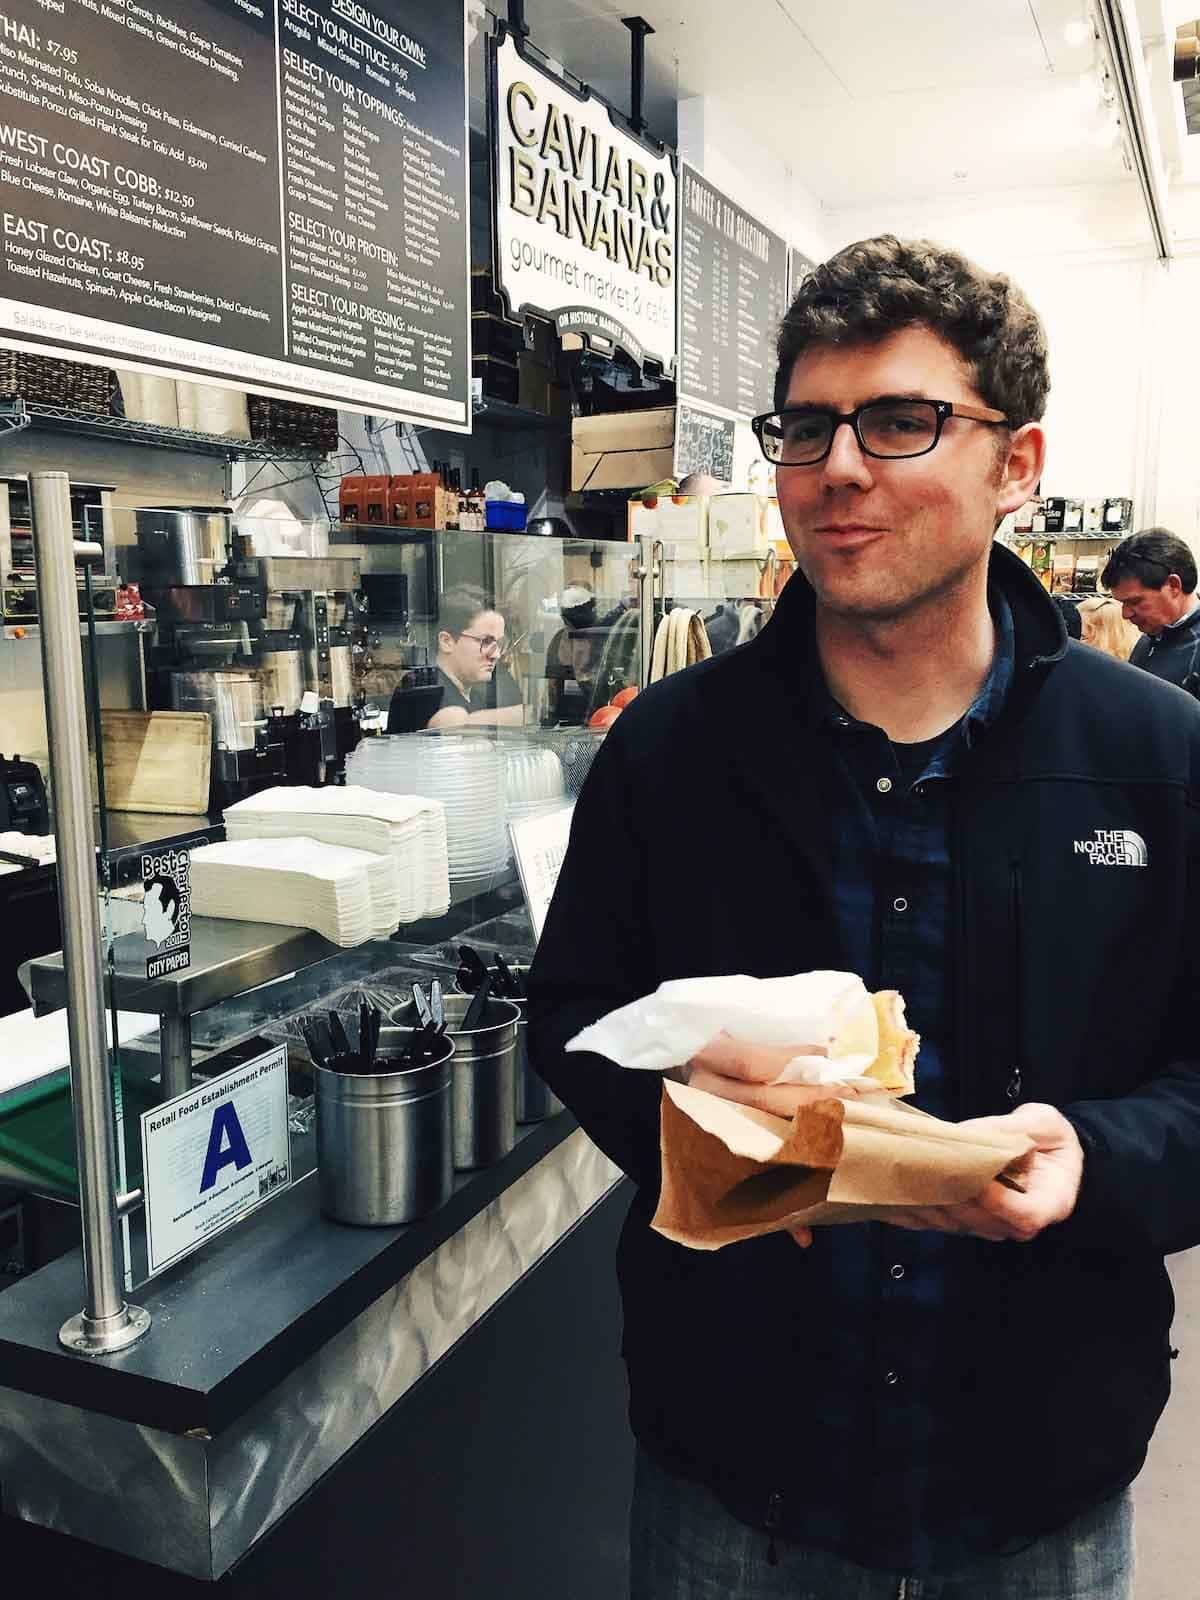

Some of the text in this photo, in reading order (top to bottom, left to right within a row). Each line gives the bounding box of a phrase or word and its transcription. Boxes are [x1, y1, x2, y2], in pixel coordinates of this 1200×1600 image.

[46, 39, 77, 64] $7.95
[100, 4, 125, 24] Mixed
[126, 16, 154, 40] Greens,
[155, 31, 178, 50] Green
[178, 43, 209, 65] Goddess
[210, 57, 239, 81] Dressing,
[282, 0, 321, 28] SELECT
[320, 15, 348, 46] YOUR
[332, 0, 370, 28] DESIGN
[371, 14, 398, 46] YOUR
[17, 50, 61, 77] Marinated
[63, 68, 82, 88] Tofu,
[84, 78, 104, 95] Soba
[106, 87, 140, 112] Noodles,
[141, 102, 162, 120] Chick
[162, 111, 181, 128] Peas,
[182, 119, 217, 144] Edamame,
[30, 74, 66, 99] Spinach,
[68, 89, 114, 116] Miso-Ponzu
[115, 108, 147, 133] Dressing
[283, 47, 407, 129] SELECT YOUR TOPPINGS:
[41, 96, 67, 115] Ponzu
[68, 107, 95, 126] Grilled
[97, 118, 117, 136] Flank
[118, 126, 139, 144] Steak
[140, 134, 151, 148] for
[152, 139, 168, 154] Tofu
[168, 147, 184, 160] Add
[507, 81, 649, 222] CAVIAR
[0, 124, 194, 207] WEST COAST COBB: $12.50
[0, 150, 278, 254] Fresh Lobster Claw, Organic Egg, Turkey Bacon, Sunflower Seeds, Pickled Grapes,
[0, 169, 186, 238] Blue Cheese, Romaine, White Balsamic Reduction
[509, 146, 672, 288] BANANAS
[3, 213, 144, 270] EAST COAST: $8.95
[288, 211, 398, 267] SELECT YOUR PROTEIN:
[4, 240, 270, 322] Honey Glazed Chicken, Goat Cheese, Fresh Strawberries, Dried Cranberries,
[6, 258, 40, 277] Toasted
[42, 268, 83, 290] Hazelnuts,
[85, 279, 117, 298] Spinach,
[118, 288, 142, 304] Apple
[186, 305, 221, 322] Vinaigrette
[291, 282, 405, 331] SELECT YOUR DRESSING:
[510, 238, 579, 289] gourmet
[584, 273, 630, 312] market
[13, 311, 46, 331] Salads
[559, 314, 570, 328] ON
[570, 312, 599, 326] HISTORIC
[142, 851, 176, 878] Best
[1074, 840, 1124, 853] NORTH
[1089, 853, 1126, 865] FACE
[1094, 830, 1123, 842] THE
[178, 851, 191, 942] Charleston
[148, 959, 165, 978] CITY
[166, 952, 189, 971] PAPER
[150, 1057, 284, 1132] Retail Food Establishment Permit
[199, 1100, 252, 1194] A
